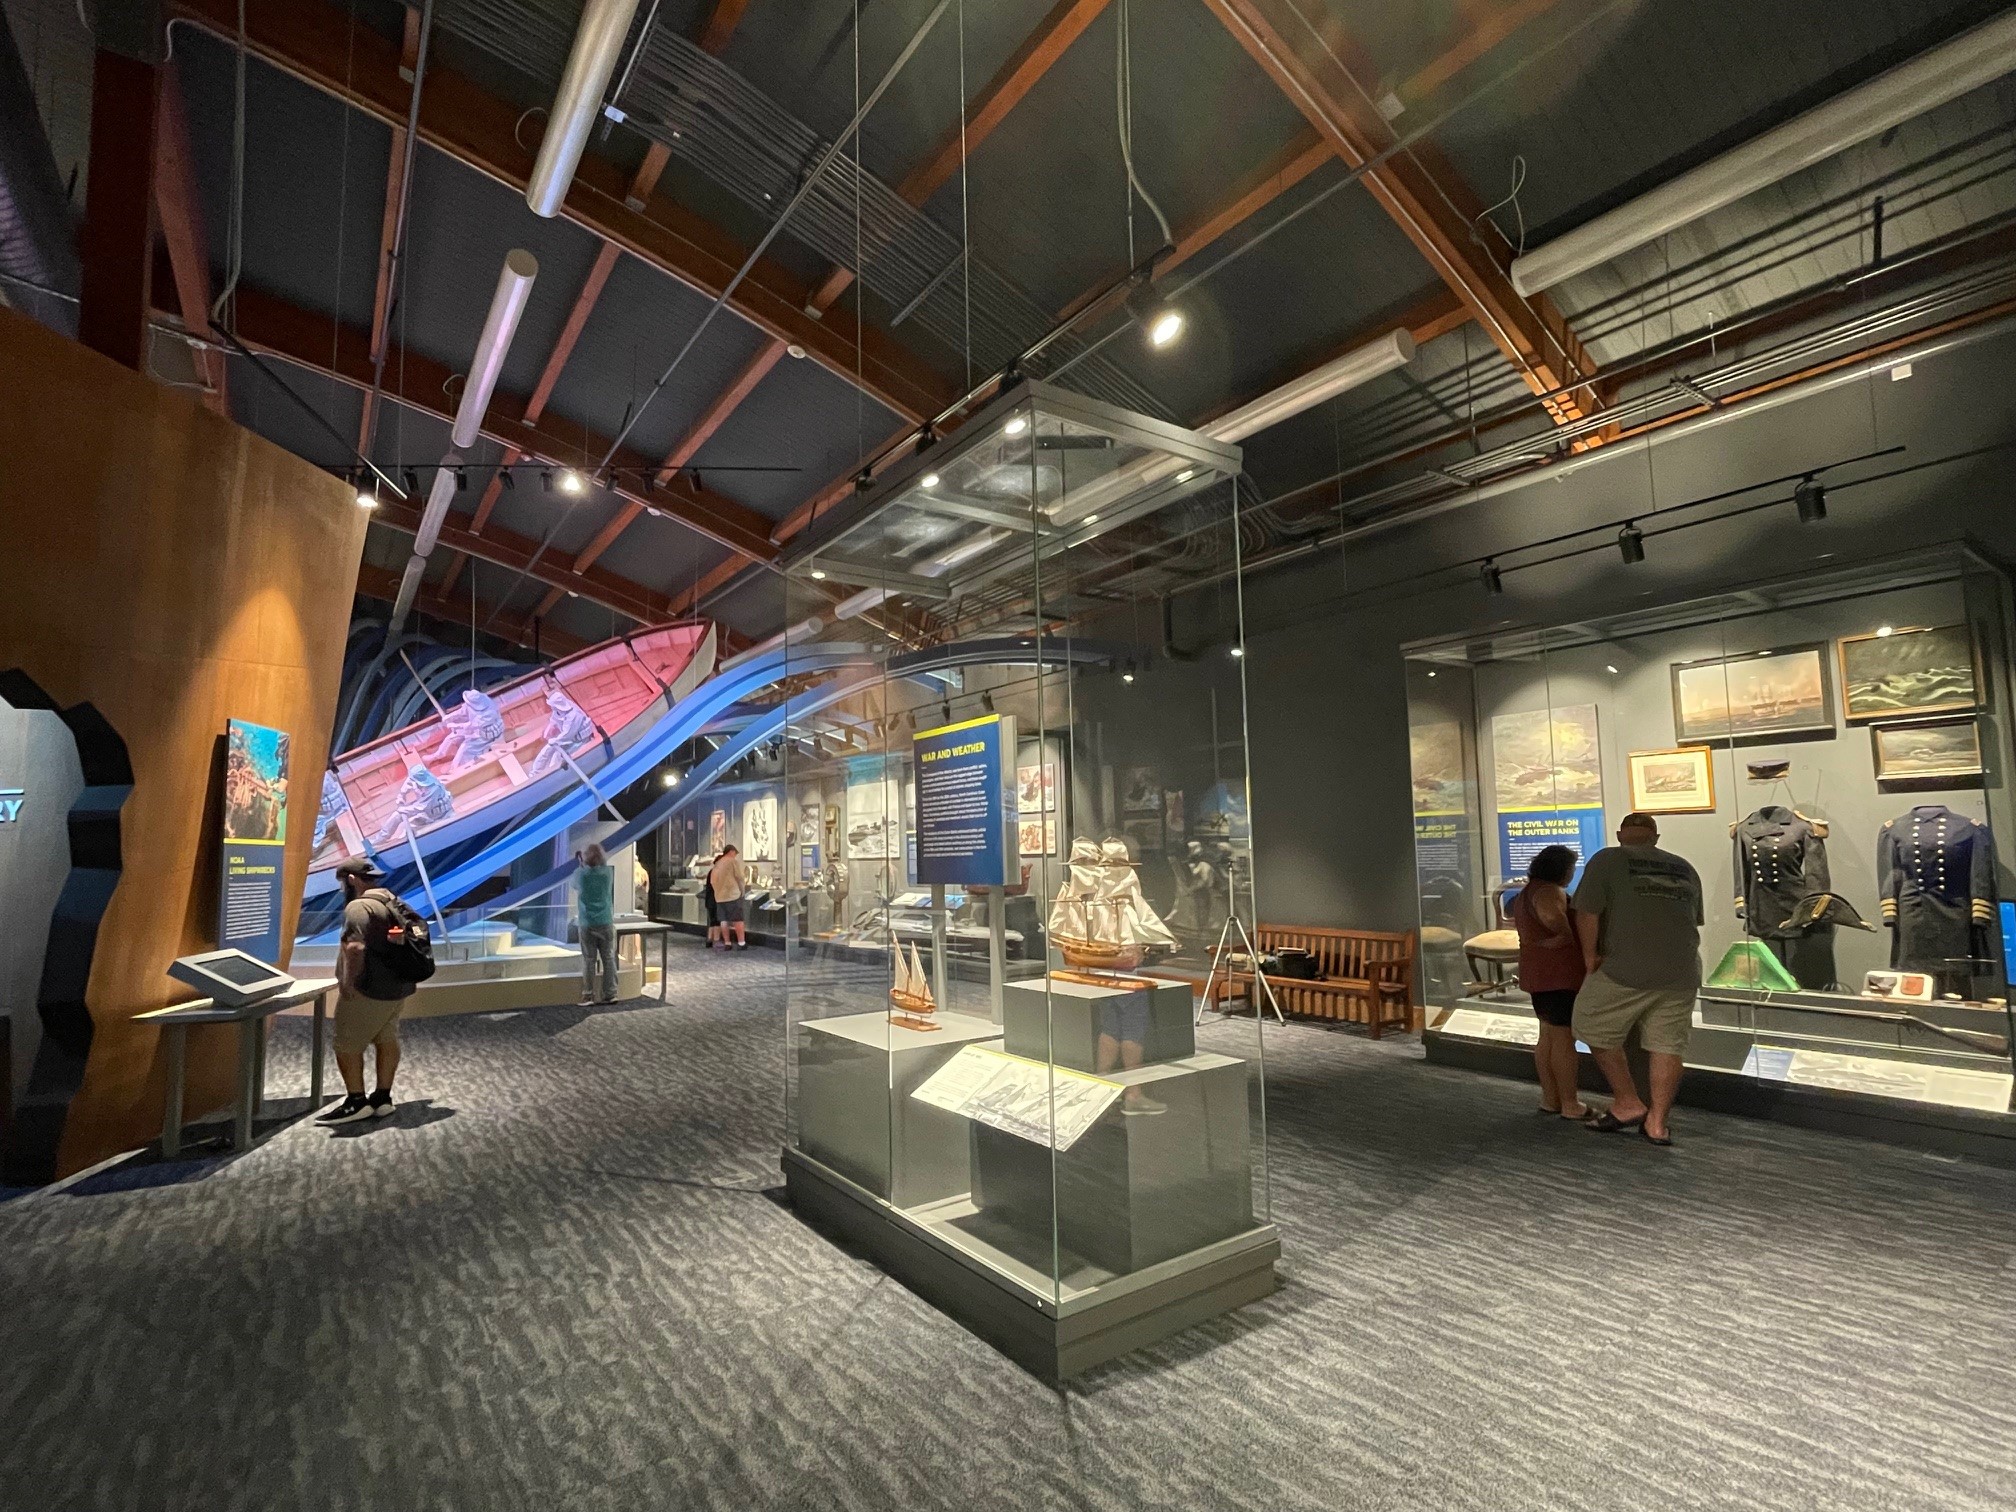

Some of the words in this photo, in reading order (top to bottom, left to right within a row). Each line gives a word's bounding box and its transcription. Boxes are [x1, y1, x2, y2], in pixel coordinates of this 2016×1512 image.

[921, 751, 936, 762] WAR
[937, 749, 951, 760] AND
[951, 741, 985, 756] WEATHER
[1507, 821, 1522, 829] THE
[1523, 820, 1543, 828] CIVIL
[1565, 819, 1579, 827] ON
[1508, 829, 1522, 837] THE
[1524, 828, 1550, 836] OUTER
[1552, 827, 1580, 835] BANKS
